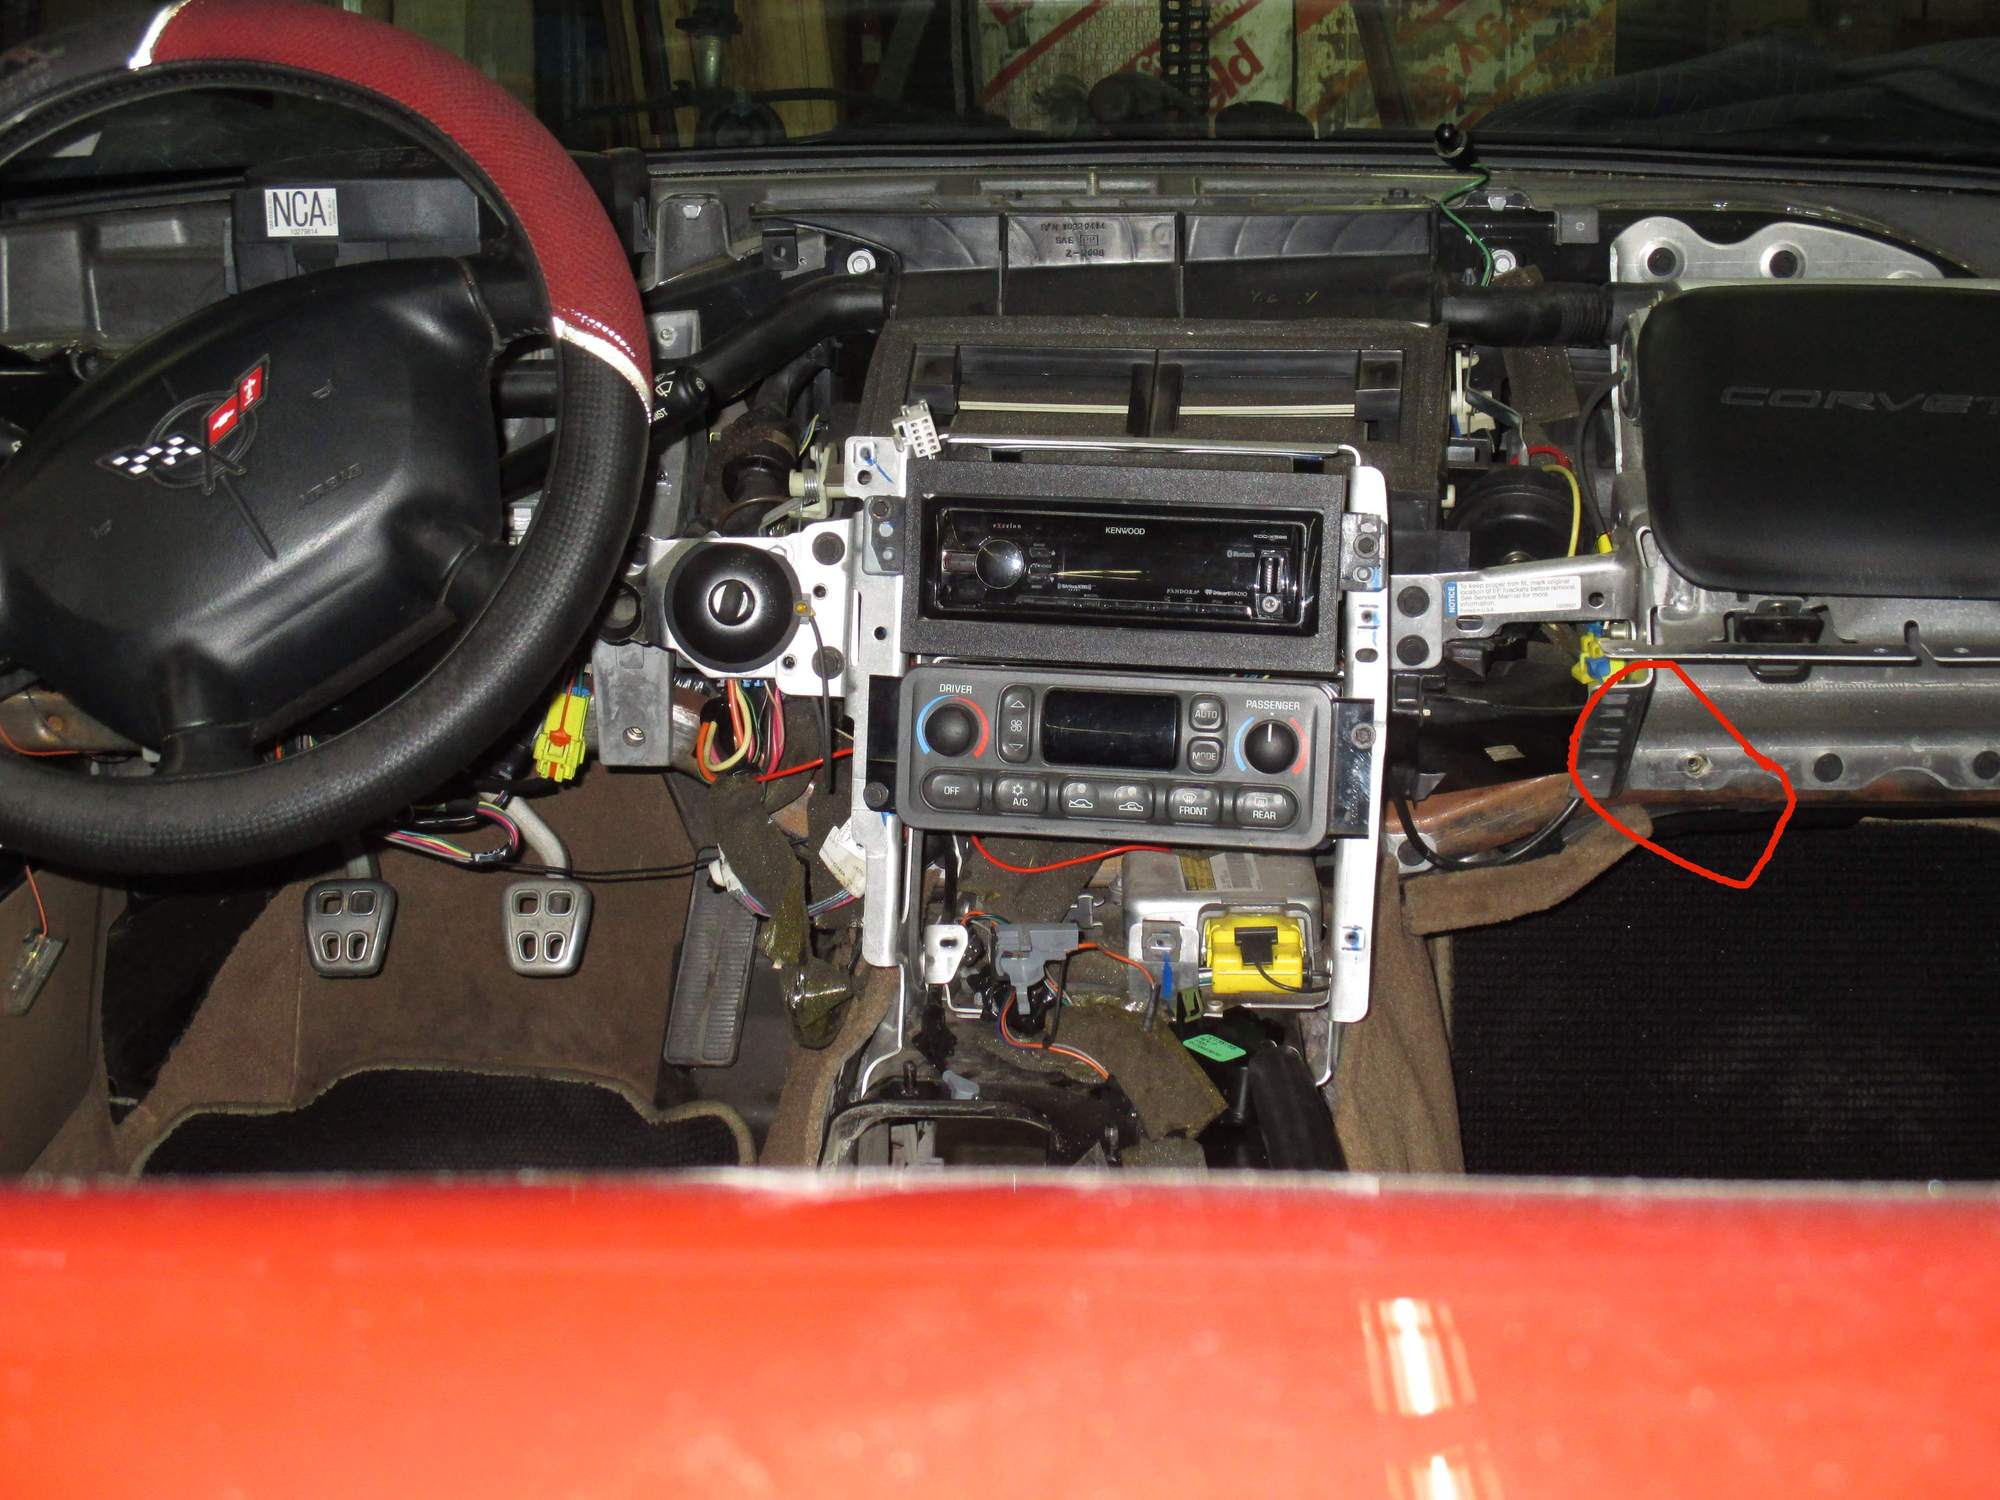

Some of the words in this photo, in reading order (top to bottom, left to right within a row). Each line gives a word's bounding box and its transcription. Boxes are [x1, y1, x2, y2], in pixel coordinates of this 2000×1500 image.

[272, 190, 328, 228] NCA
[1105, 526, 1146, 535] KENWOOD
[939, 683, 972, 695] DRIVER
[1246, 700, 1301, 712] PASSENGER
[1194, 709, 1218, 720] AUTO
[1192, 751, 1217, 762] MODE
[944, 786, 960, 795] OFF
[1012, 797, 1029, 807] A/C
[1178, 806, 1208, 816] FRONT
[1252, 810, 1277, 820] REAR
